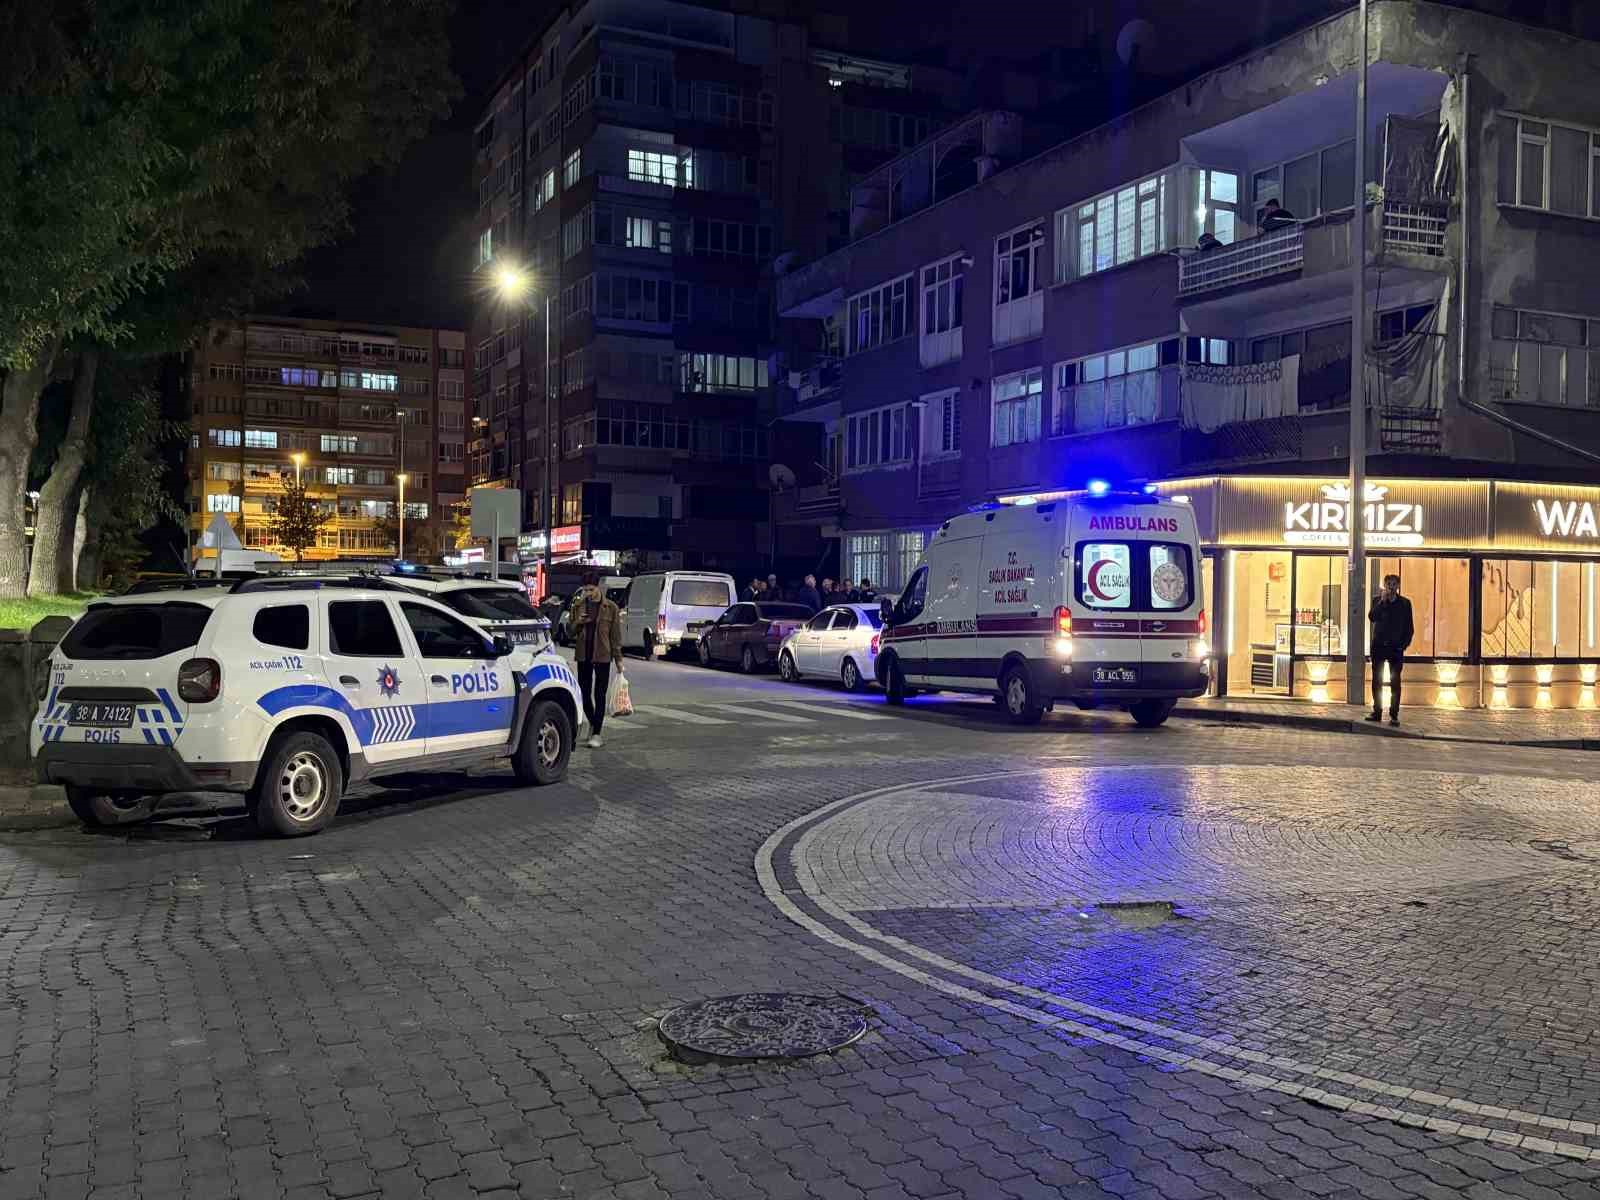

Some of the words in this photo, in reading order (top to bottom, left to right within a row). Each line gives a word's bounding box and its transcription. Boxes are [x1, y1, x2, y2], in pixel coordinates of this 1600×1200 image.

[1089, 516, 1178, 532] AMBULANS
[936, 619, 976, 633] AMBULANS
[282, 655, 303, 669] 112
[55, 672, 65, 685] 112
[451, 664, 499, 694] POLİS
[75, 704, 89, 721] 38
[91, 705, 99, 721] A
[103, 705, 131, 722] 74122
[84, 728, 121, 743] POLİS
